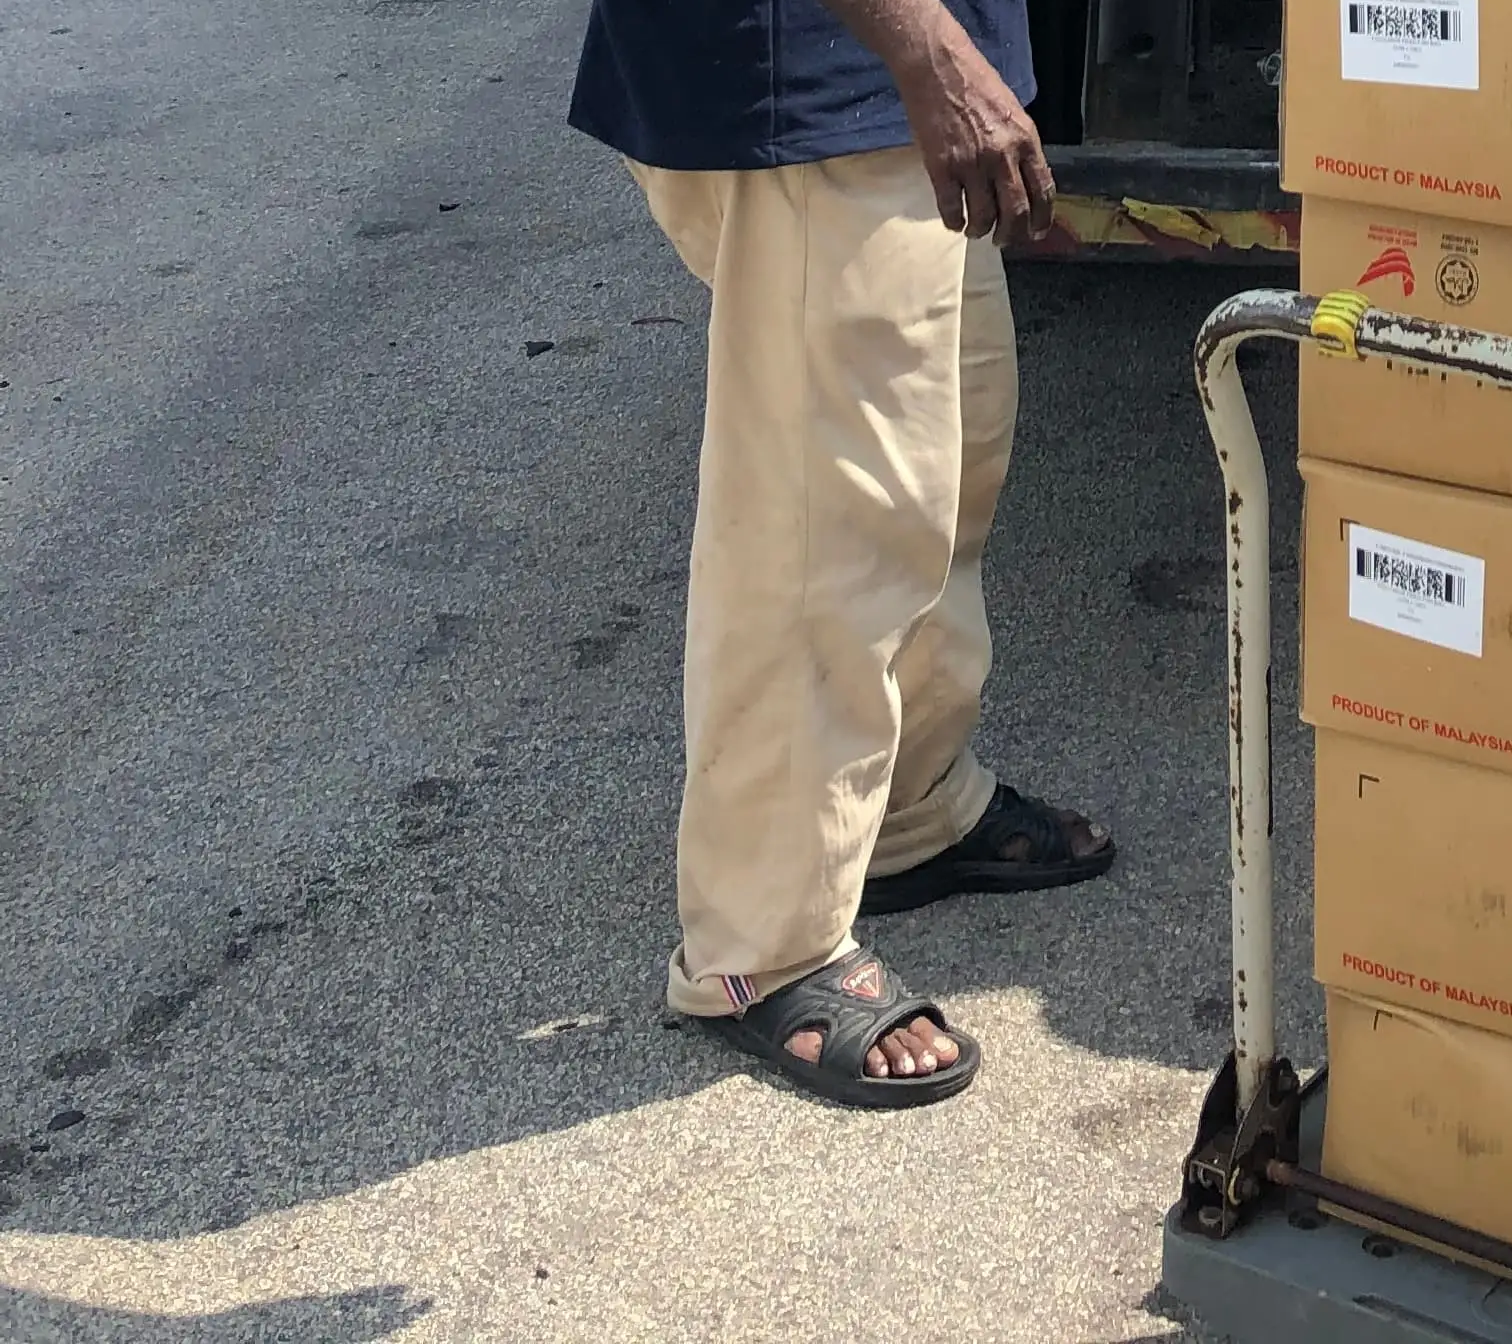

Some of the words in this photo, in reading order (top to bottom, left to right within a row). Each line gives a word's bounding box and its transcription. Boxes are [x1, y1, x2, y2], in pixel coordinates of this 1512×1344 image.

[1315, 155, 1388, 184] PRODUCT
[1394, 169, 1415, 187] OF
[1419, 173, 1502, 201] MALAYSIA
[1332, 694, 1404, 728] PRODUCT
[1408, 716, 1430, 735] OF
[1342, 952, 1416, 990] PRODUCT
[1419, 978, 1441, 995] OF
